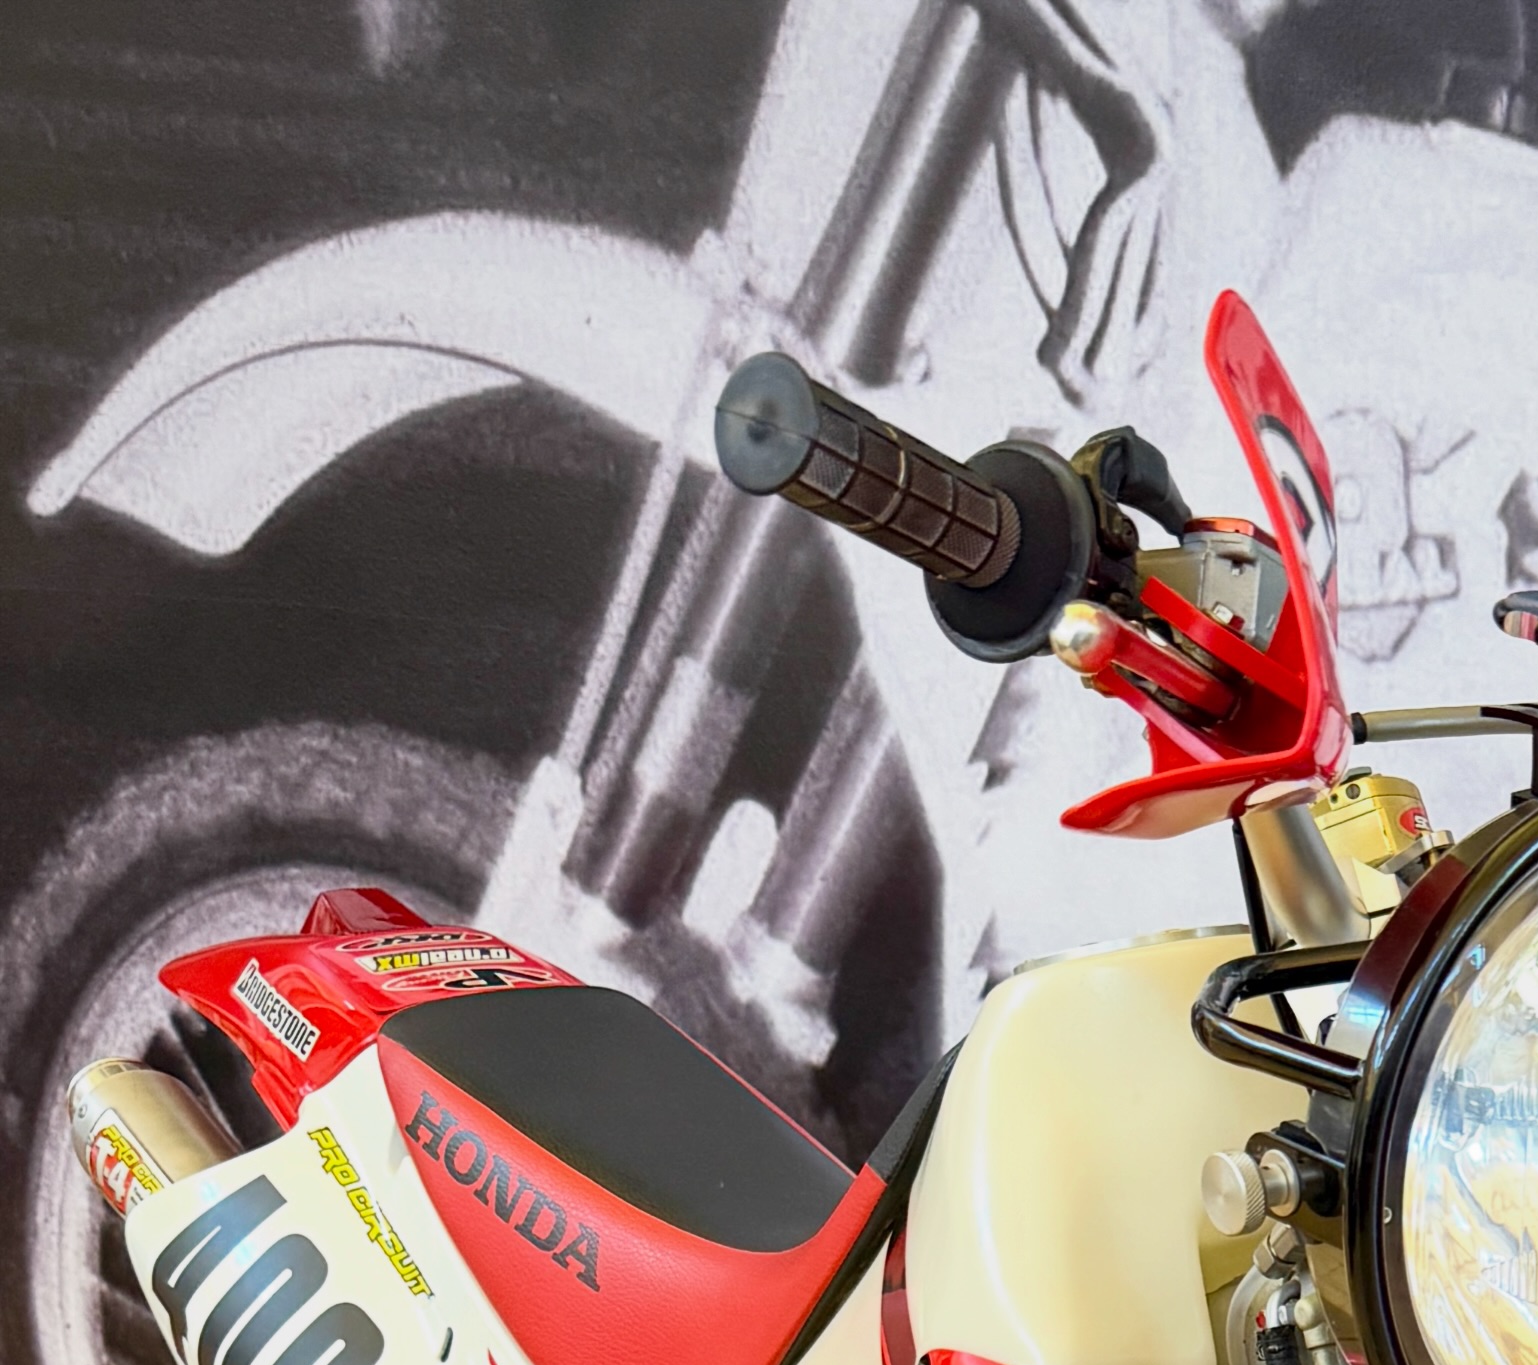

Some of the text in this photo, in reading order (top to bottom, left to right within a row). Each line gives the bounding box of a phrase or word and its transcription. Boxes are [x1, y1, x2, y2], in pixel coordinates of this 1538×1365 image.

[236, 965, 317, 1058] BRIDGESTONE
[103, 1124, 144, 1170] PRO
[307, 1126, 435, 1298] PRO CIRCUIT
[403, 1091, 602, 1293] HONDA
